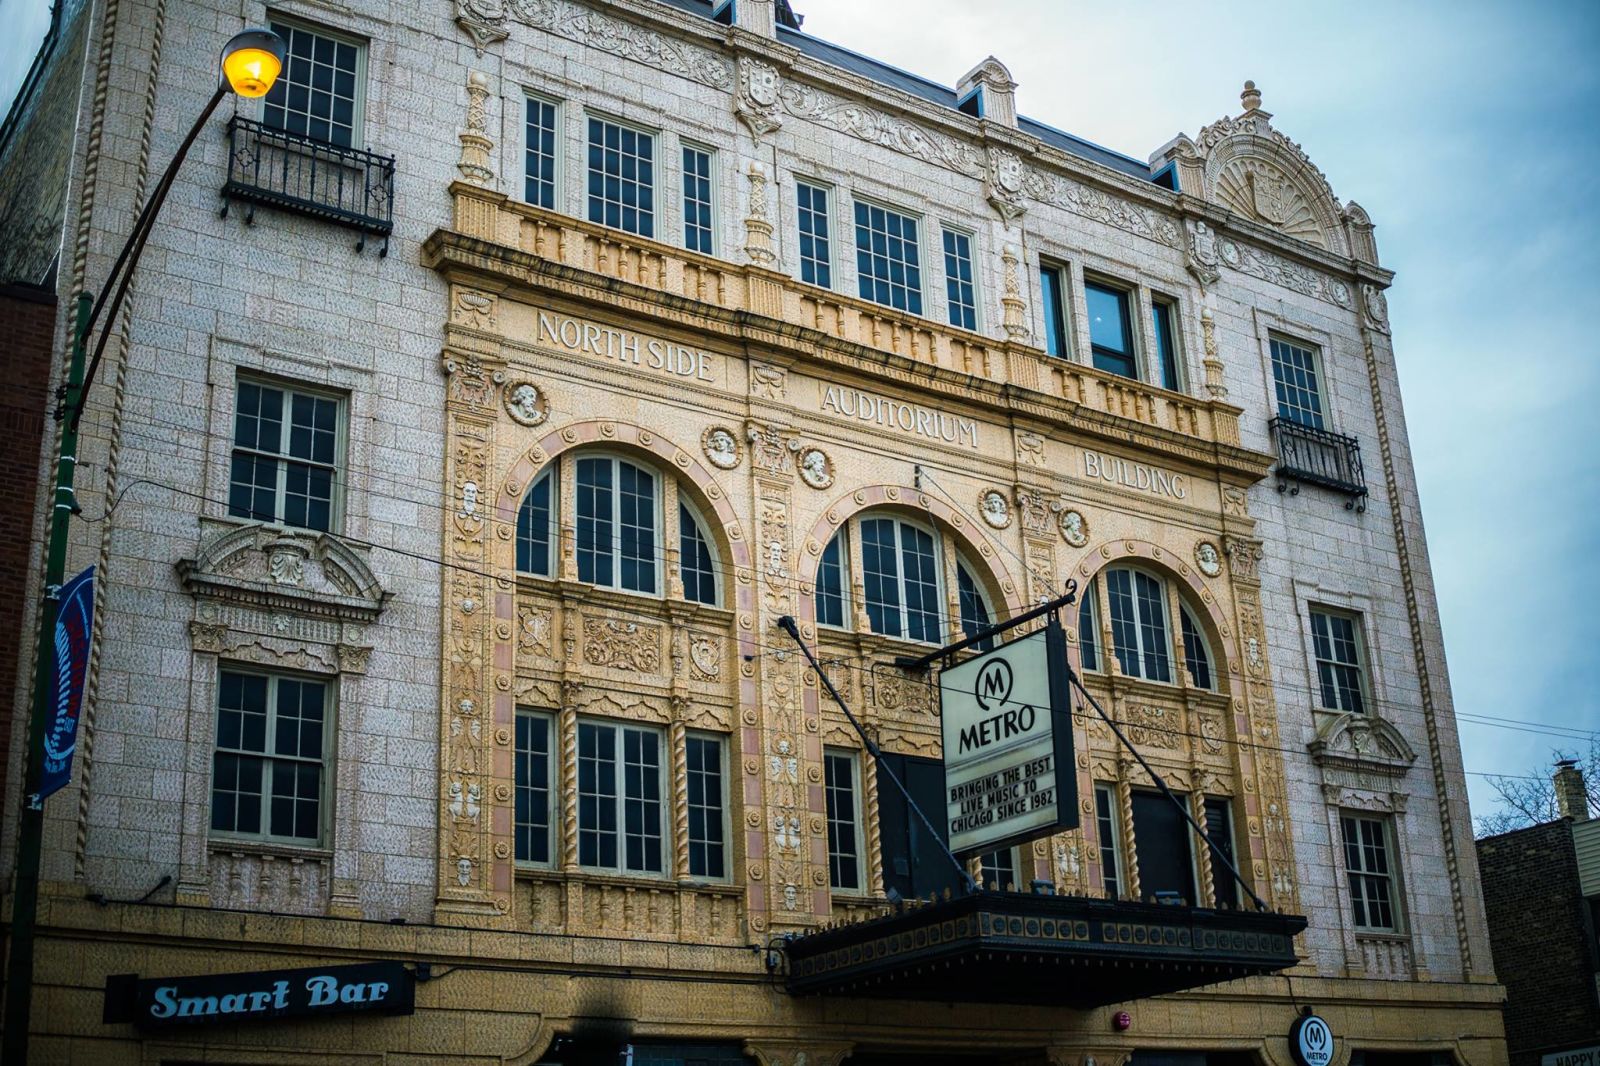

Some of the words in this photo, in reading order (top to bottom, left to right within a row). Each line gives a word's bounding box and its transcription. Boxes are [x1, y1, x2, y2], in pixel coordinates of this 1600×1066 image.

[538, 312, 640, 364] NORTH
[647, 339, 715, 383] SIDE
[821, 386, 978, 448] AUDITORIUM
[1084, 449, 1186, 499] BUILDING
[959, 704, 1035, 754] METRO
[951, 775, 999, 801] BRINGING
[1003, 768, 1020, 785] THE
[1024, 757, 1050, 778] BEST
[961, 796, 983, 814] LIVE
[988, 785, 1019, 807] MUSIC
[1024, 779, 1037, 795] TO
[951, 810, 993, 833] CHICAGO
[998, 798, 1026, 820] SINCE
[1030, 790, 1052, 809] 1982
[150, 981, 290, 1018] Smart
[305, 975, 389, 1007] Bar
[1306, 1051, 1328, 1061] METRO
